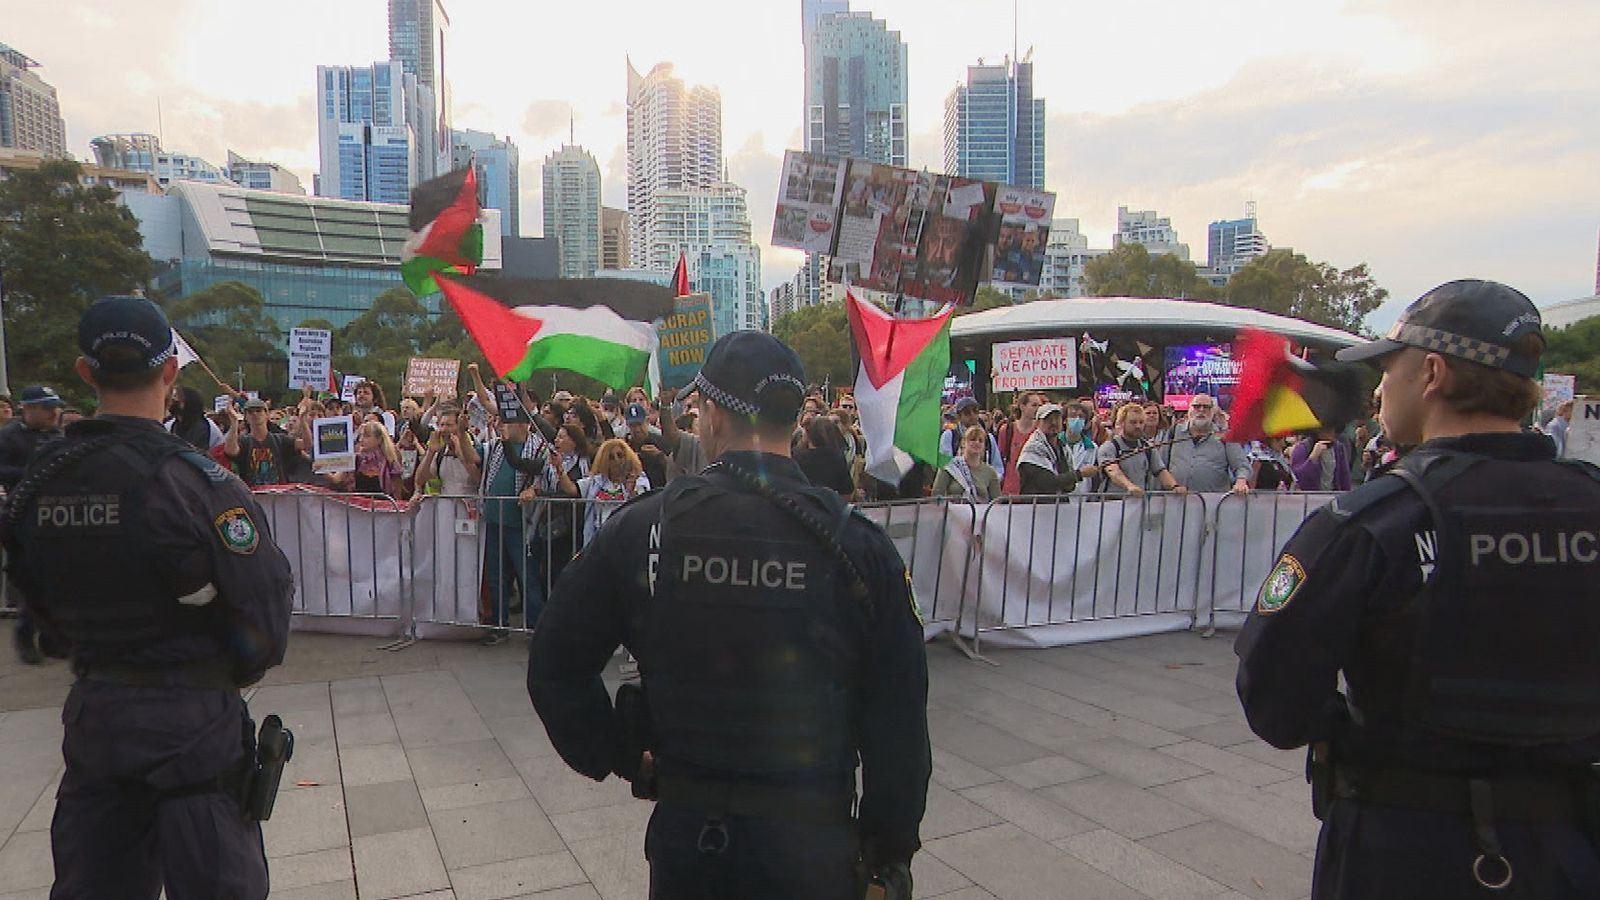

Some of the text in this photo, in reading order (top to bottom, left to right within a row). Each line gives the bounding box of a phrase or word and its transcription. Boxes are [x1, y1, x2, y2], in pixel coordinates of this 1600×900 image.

[660, 329, 709, 348] AUKUS
[669, 348, 705, 366] NOW
[1000, 345, 1067, 360] SEPARATE
[1000, 358, 1068, 373] WEAPONS
[994, 375, 1074, 389] FROM PROFIT
[38, 504, 121, 527] POLICE
[1470, 530, 1600, 567] POLIC
[682, 554, 807, 591] POLICE
